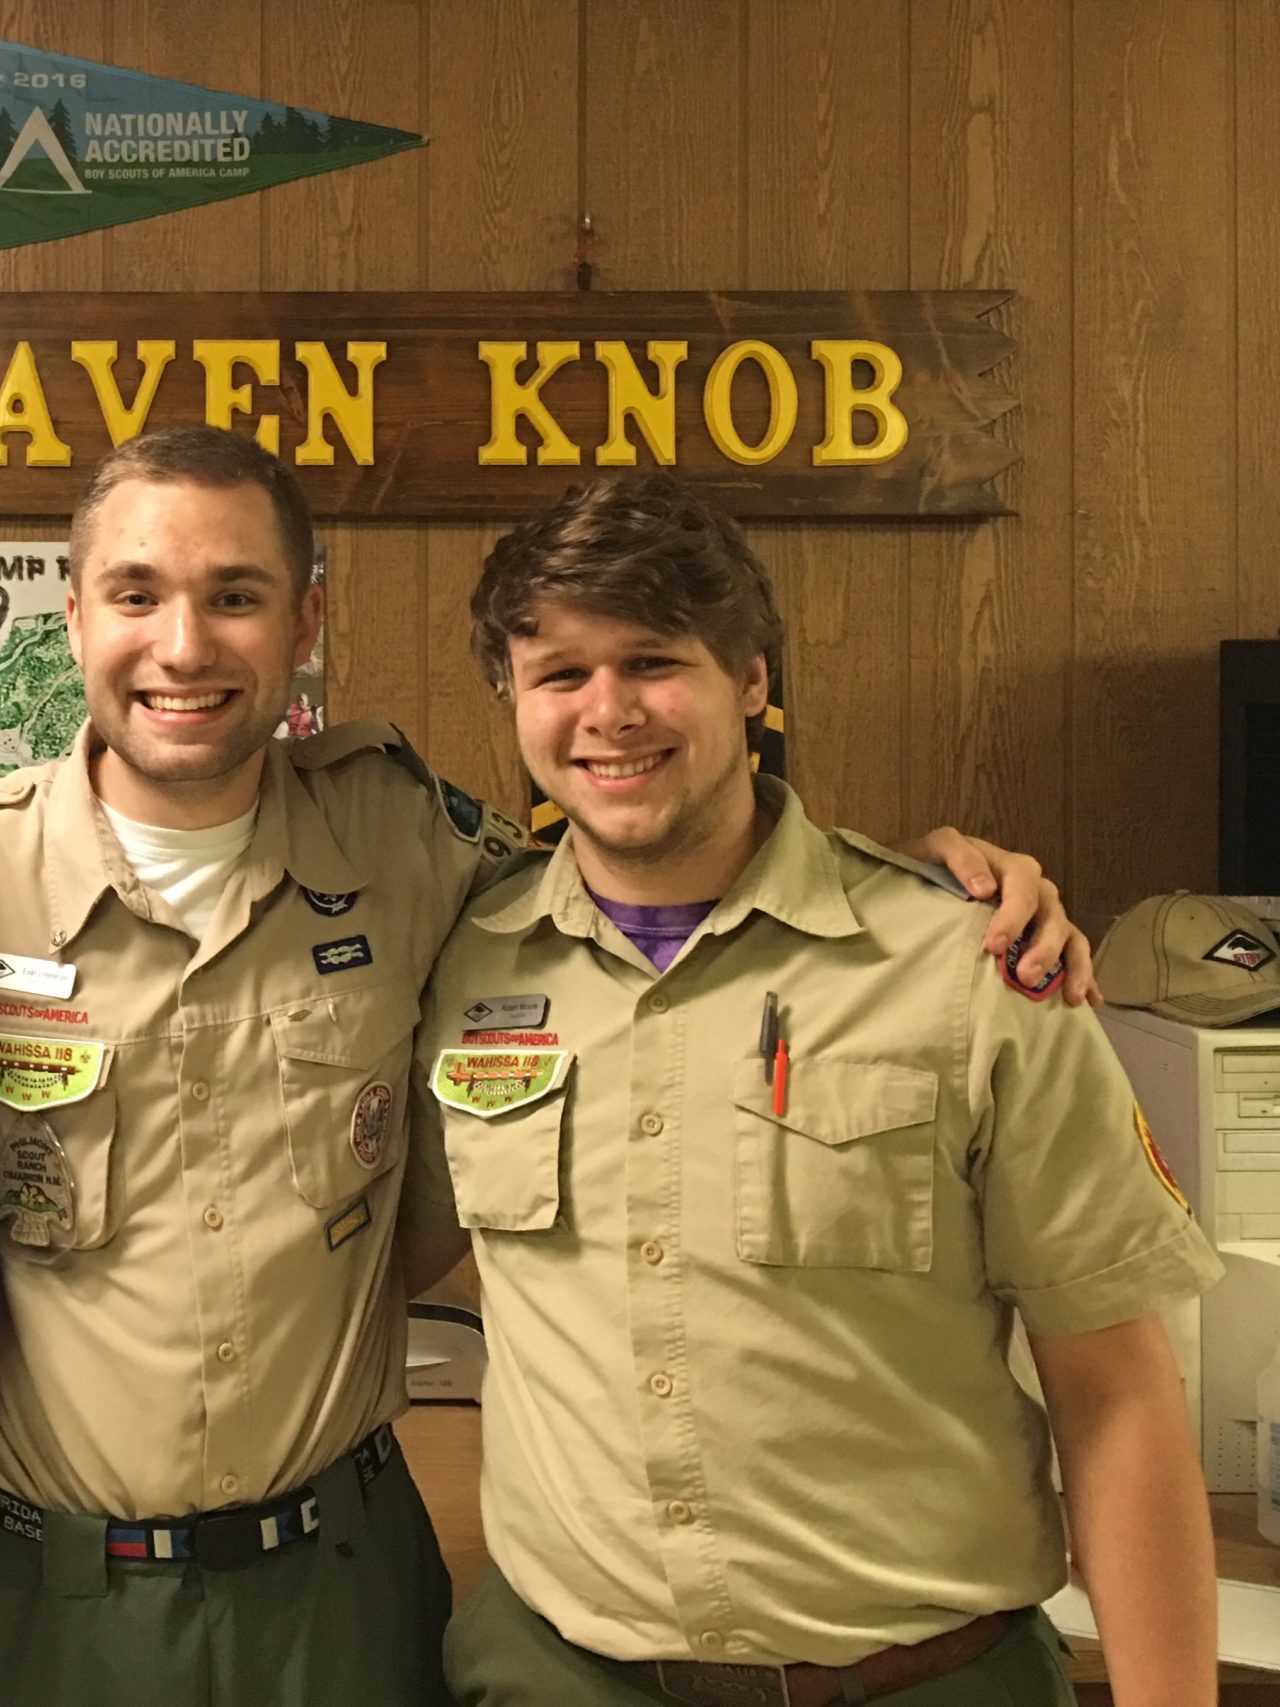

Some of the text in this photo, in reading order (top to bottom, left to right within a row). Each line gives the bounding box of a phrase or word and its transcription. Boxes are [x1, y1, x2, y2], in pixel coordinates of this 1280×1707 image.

[13, 72, 87, 89] 2016
[84, 110, 248, 137] NATIONALLY
[84, 137, 251, 163] ACCREDITED
[84, 167, 250, 180] BOY SCOUTS OF AMERICA CAMP
[477, 339, 910, 467] KNOB
[42, 1009, 89, 1024] AMERICA
[518, 1032, 559, 1046] AMERICA
[466, 1055, 519, 1068] WAHISSA
[17, 1150, 46, 1162] SCOUT
[17, 1161, 47, 1173] RANCH
[4, 1515, 43, 1541] BASE
